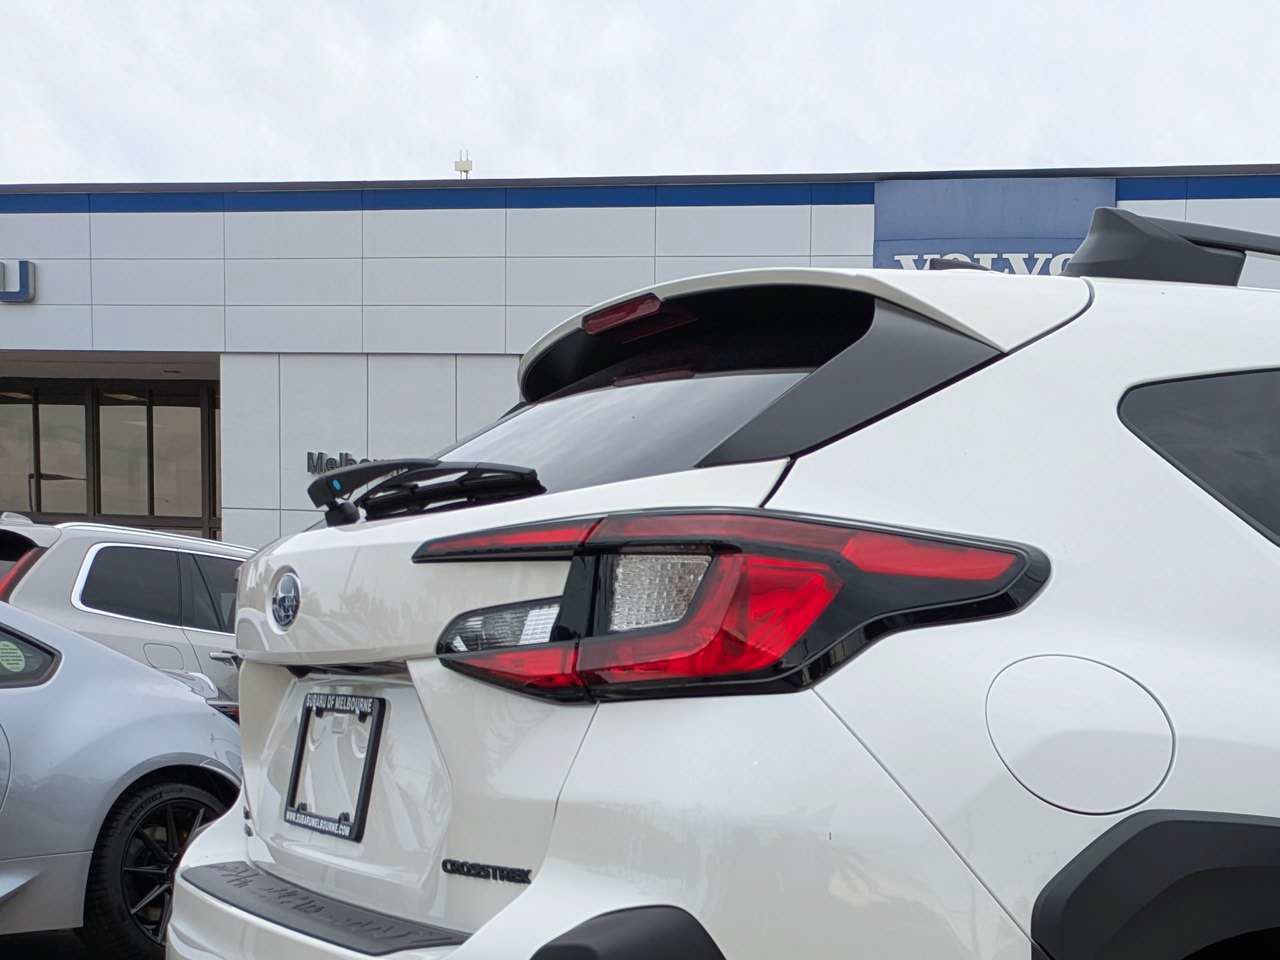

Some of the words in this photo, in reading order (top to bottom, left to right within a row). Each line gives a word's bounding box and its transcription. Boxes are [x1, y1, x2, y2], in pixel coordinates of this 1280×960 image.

[894, 253, 1075, 276] VLV
[307, 452, 377, 474] Melb
[335, 696, 373, 712] MELBOURNE
[442, 859, 532, 884] CROSSTREK
